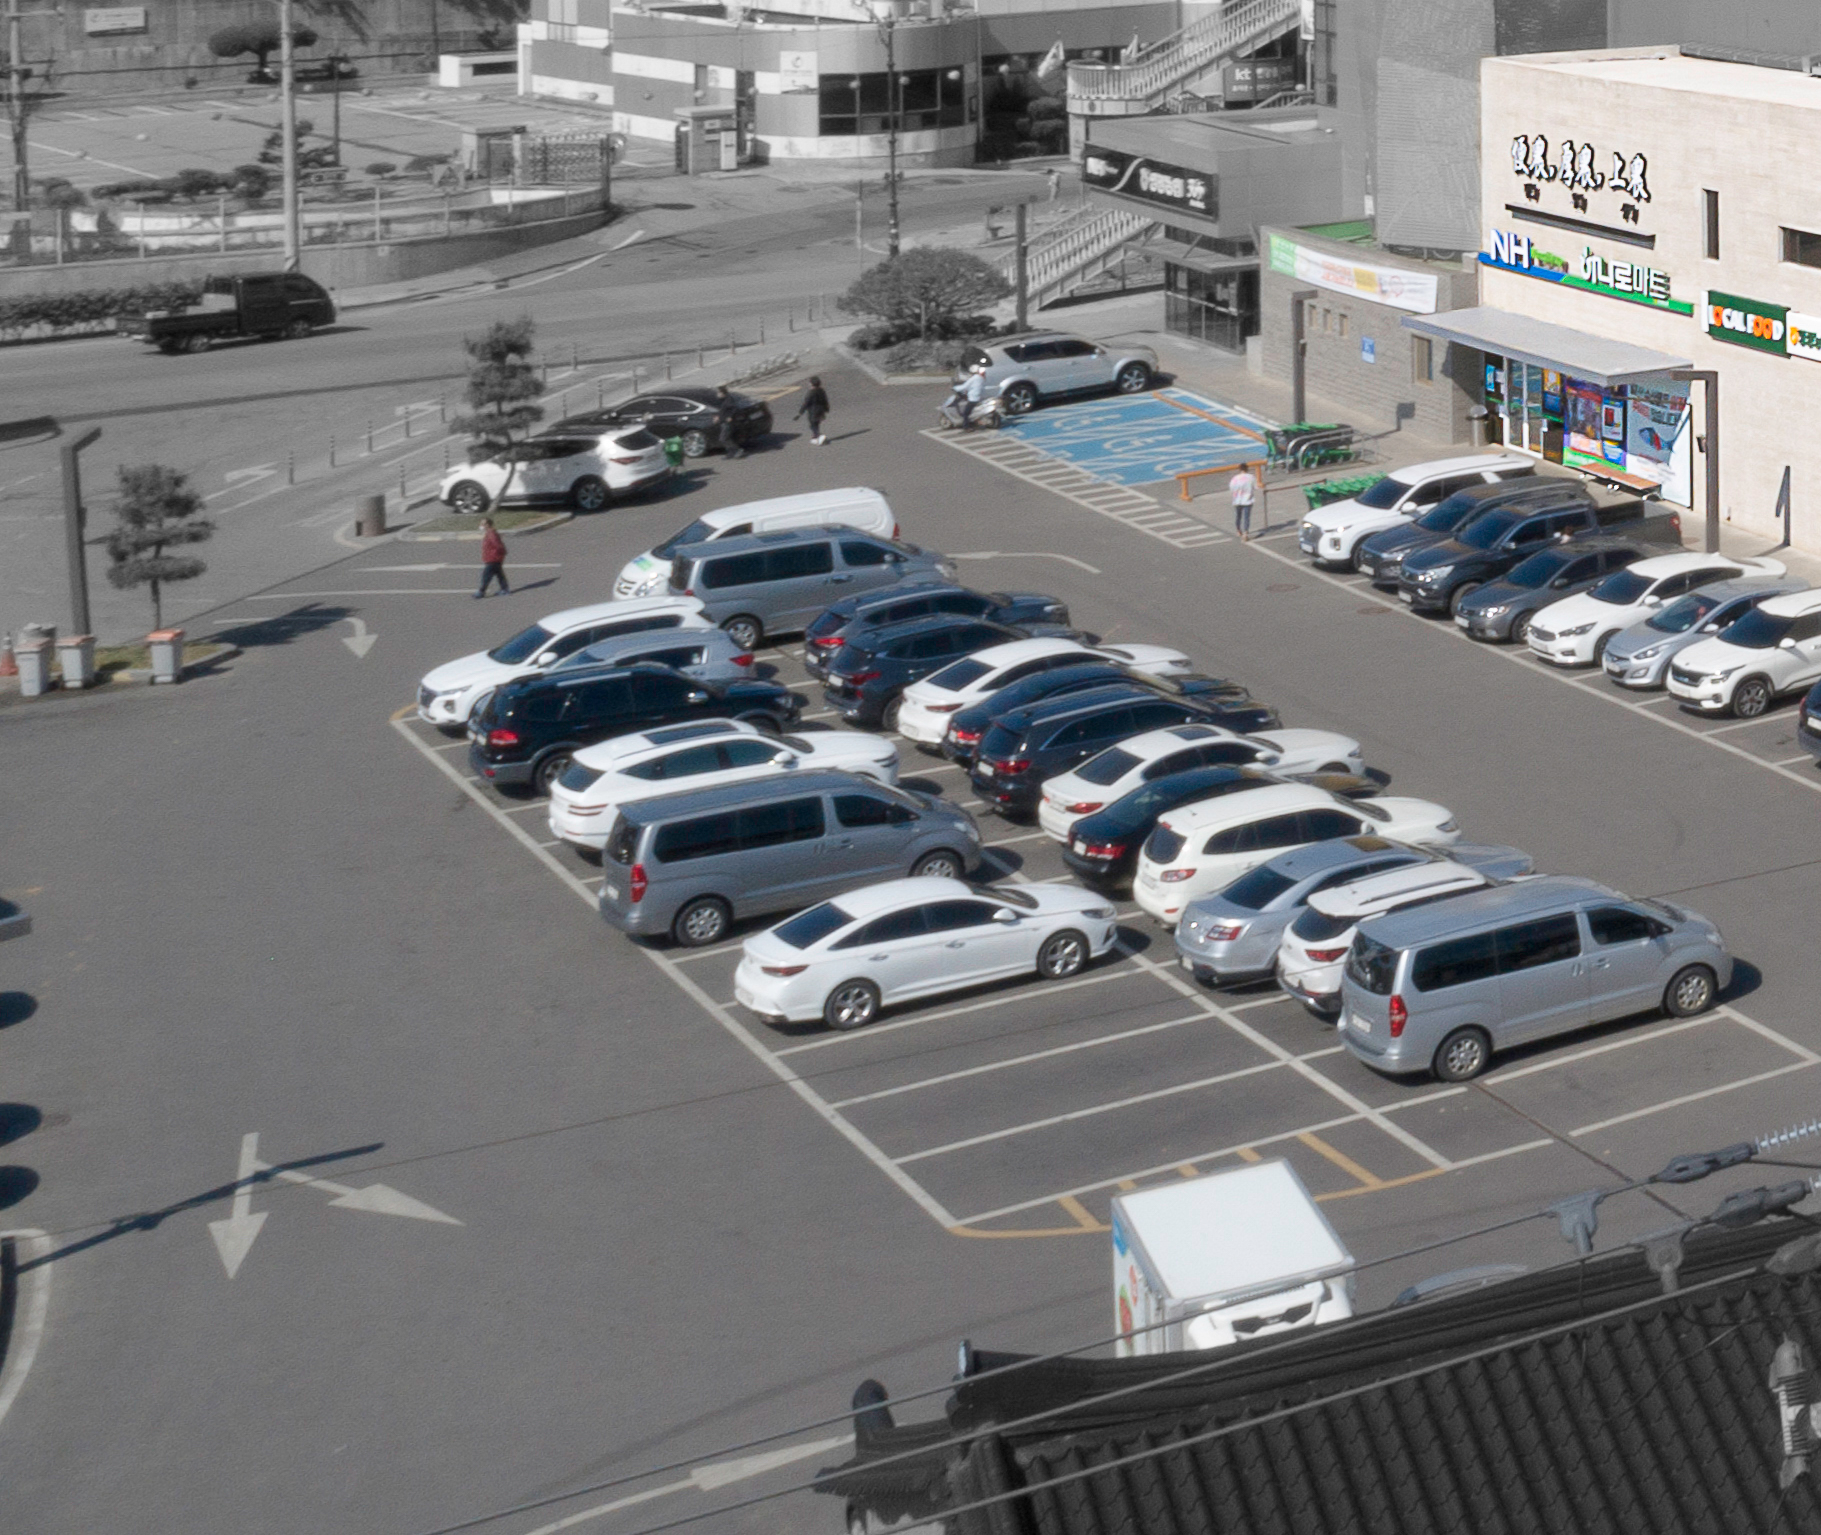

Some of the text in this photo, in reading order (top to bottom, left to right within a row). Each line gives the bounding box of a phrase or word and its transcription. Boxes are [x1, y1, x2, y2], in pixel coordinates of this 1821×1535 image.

[1489, 228, 1531, 270] NH
[1579, 246, 1671, 301] 하나로마트
[1708, 304, 1785, 341] LOCAL FOOD
